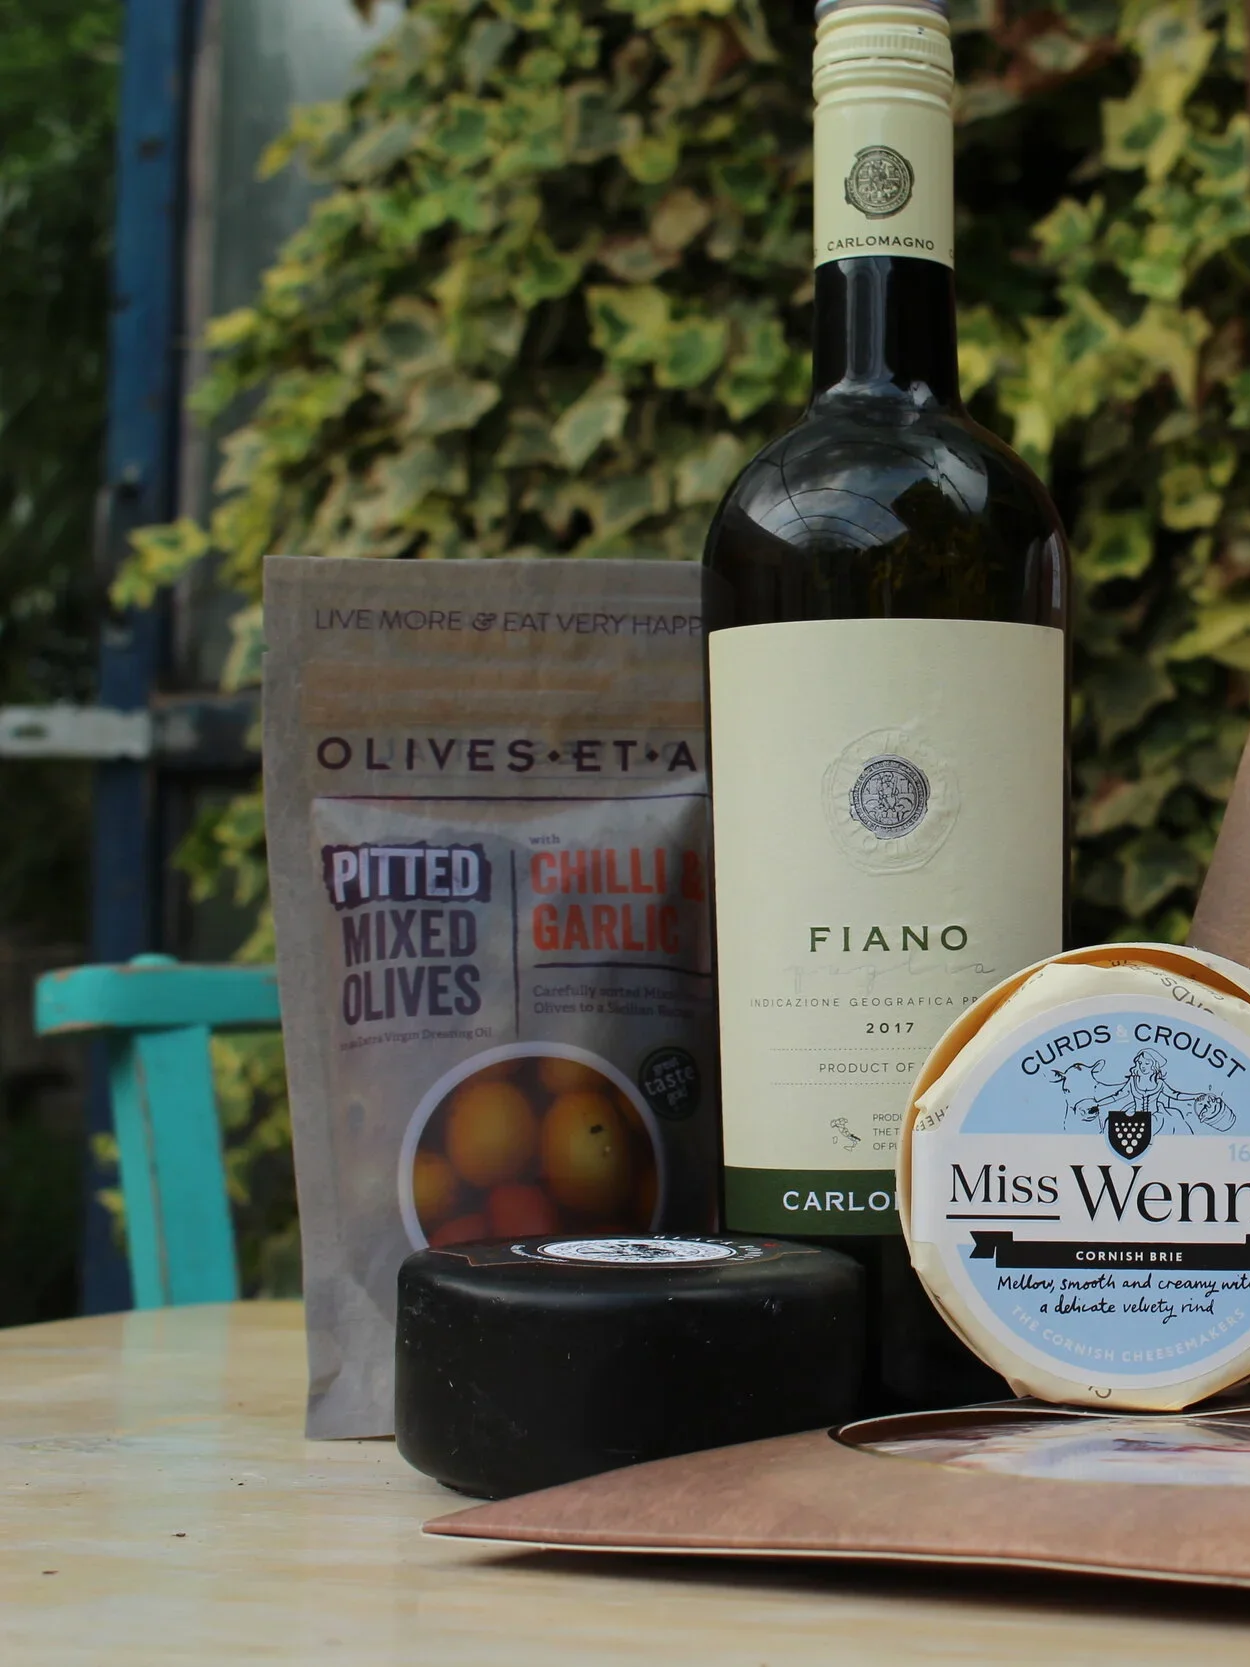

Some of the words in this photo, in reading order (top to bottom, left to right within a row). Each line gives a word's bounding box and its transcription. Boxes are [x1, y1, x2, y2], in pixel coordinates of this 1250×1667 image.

[827, 236, 934, 251] CARLOMAGNO
[315, 609, 373, 630] LIVE
[379, 610, 462, 631] MORE
[472, 612, 497, 632] &
[504, 612, 549, 633] EAT
[556, 613, 626, 634] VERY
[530, 833, 560, 846] with
[332, 847, 480, 903] PITTED
[530, 848, 667, 896] CHILLI
[341, 910, 477, 967] MIXED
[532, 903, 680, 955] GARLIC
[810, 925, 968, 952] FIANO
[341, 964, 482, 1026] OLIVES
[750, 997, 840, 1008] INDICAZIONE
[850, 997, 953, 1008] GEOGRAFICA
[866, 1022, 915, 1034] 2017
[1021, 1025, 1111, 1075] CURDS
[1134, 1024, 1246, 1078] CROUST
[644, 1065, 695, 1096] taste
[819, 1063, 889, 1074] PRODUCT
[896, 1063, 915, 1073] OF
[873, 1128, 891, 1136] THE
[873, 1142, 886, 1151] OF
[950, 1163, 1059, 1205] Miss
[783, 1190, 900, 1211] CARLO
[1076, 1251, 1144, 1262] CORNISH
[1150, 1252, 1183, 1262] BRIE
[997, 1274, 1056, 1294] Mellow,
[1060, 1274, 1116, 1290] smooth
[1122, 1273, 1151, 1290] and
[1158, 1277, 1219, 1297] creamy
[1040, 1303, 1048, 1314] a
[1055, 1295, 1116, 1314] delicate
[1123, 1297, 1177, 1324] velvety
[1181, 1298, 1215, 1315] rind
[1012, 1304, 1038, 1332] THE
[1042, 1328, 1115, 1362] CORNISH
[1122, 1308, 1246, 1363] CHEESEMAKERS
